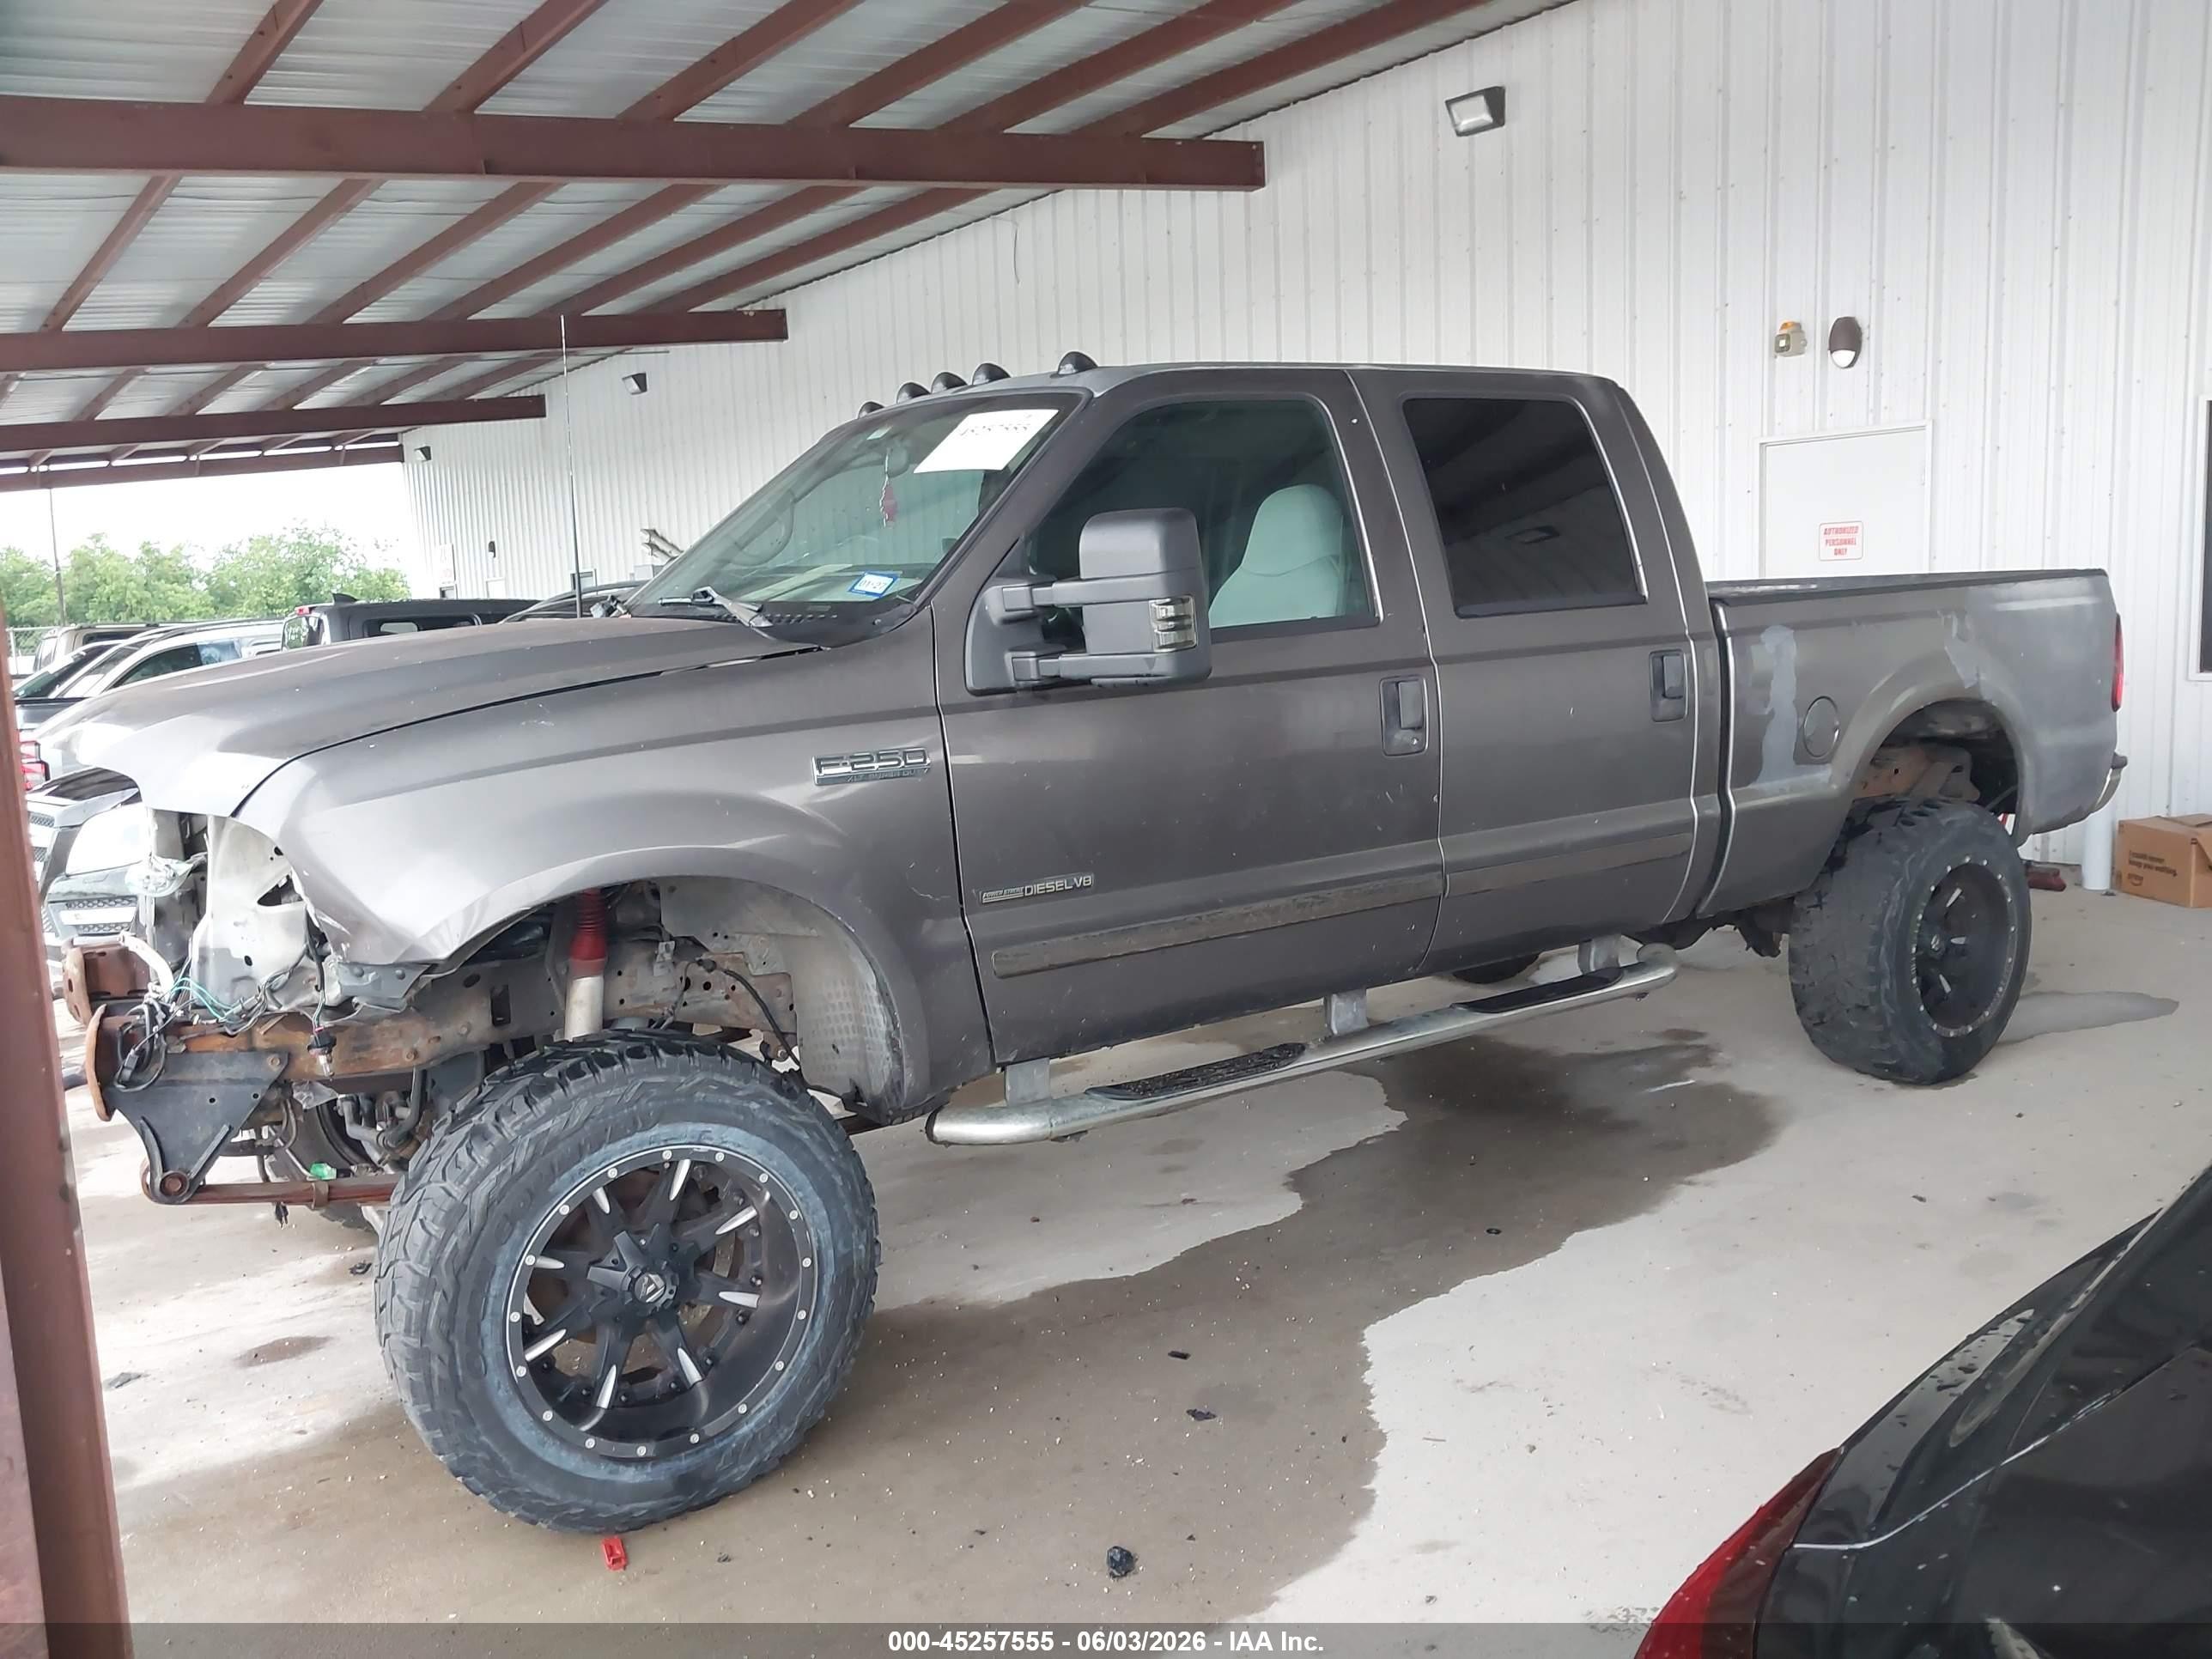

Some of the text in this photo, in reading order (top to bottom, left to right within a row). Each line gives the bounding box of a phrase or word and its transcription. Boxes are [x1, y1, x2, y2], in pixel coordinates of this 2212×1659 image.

[1824, 526, 1859, 535] AUTHORIZED
[1826, 538, 1856, 546] PERSONNEL
[815, 746, 929, 775] F-250
